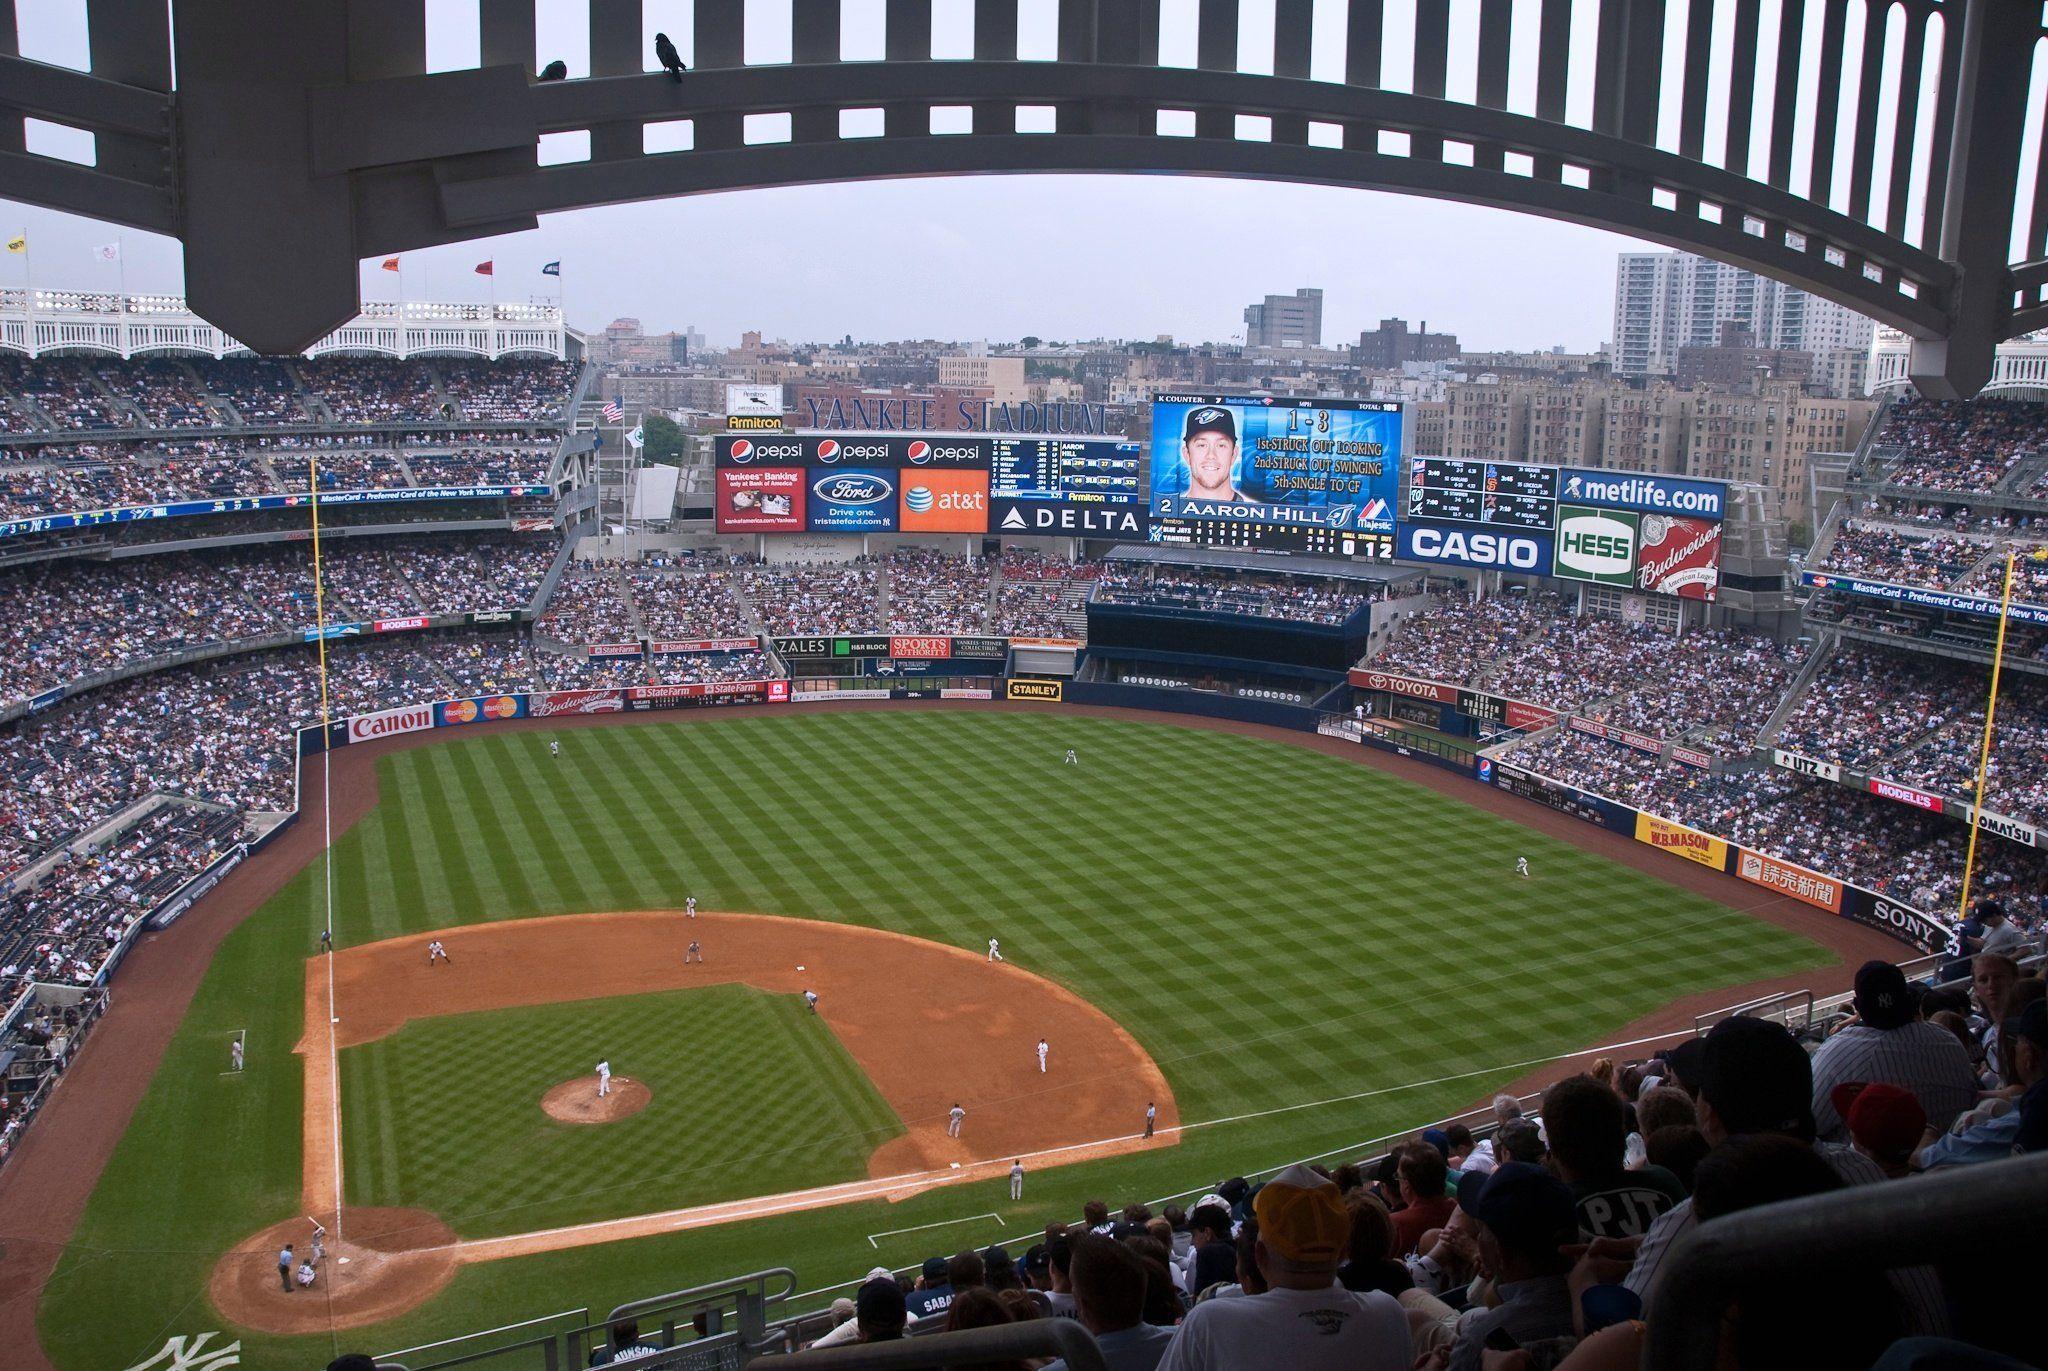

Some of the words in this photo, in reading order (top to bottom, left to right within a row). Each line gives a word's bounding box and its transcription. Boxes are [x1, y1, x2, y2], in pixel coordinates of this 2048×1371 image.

[1165, 396, 1206, 404] COUNTER:
[1359, 403, 1380, 411] TOTAL:
[729, 416, 781, 429] Armitron
[804, 398, 938, 433] YANKEE
[957, 399, 1108, 436] STADIUM
[1289, 409, 1298, 431] 1
[1318, 410, 1329, 432] 3
[756, 443, 802, 459] pepsi
[843, 444, 889, 460] pepsi
[933, 445, 979, 461] pepsi
[1256, 437, 1308, 452] 1st-STRUCK
[1311, 440, 1333, 453] OUT
[1336, 441, 1382, 456] LOOKING
[1255, 457, 1308, 471] 2nd-STRUCK
[1311, 458, 1332, 472] OUT
[1334, 461, 1382, 475] SWINGING
[764, 473, 798, 481] Banking
[1273, 476, 1325, 491] 5th-SINGLE
[1330, 478, 1345, 491] TO
[1348, 480, 1361, 493] CF
[321, 492, 361, 503] MasterCard
[366, 490, 399, 500] Preferred
[400, 490, 417, 499] Card
[418, 489, 426, 499] of
[426, 489, 438, 498] the
[440, 489, 457, 498] New
[458, 488, 474, 497] York
[475, 488, 503, 497] Yankees
[832, 479, 874, 499] Ford
[1585, 479, 1719, 513] metlife.com
[939, 490, 984, 510] at&t
[1068, 493, 1105, 502] Armitron
[152, 507, 168, 517] HILL
[829, 508, 854, 516] Drive
[1160, 499, 1172, 513] 2
[1182, 501, 1266, 519] AARON
[1272, 507, 1325, 524] HILL
[815, 517, 881, 526] tristateford.com
[1036, 508, 1139, 532] DELTA
[1358, 519, 1392, 531] Majestic
[1162, 535, 1190, 543] YANKEES
[1563, 532, 1630, 560] HESS
[1342, 540, 1355, 555] 0
[1365, 542, 1374, 557] 1
[1380, 543, 1392, 559] 2
[1411, 528, 1538, 569] CASIO
[1637, 523, 1722, 589] Budweiser
[1668, 573, 1696, 588] American
[1697, 572, 1714, 581] Lager
[1852, 582, 1901, 598] MasterCard
[1908, 591, 1950, 606] Preferred
[1952, 597, 1973, 611] Card
[1975, 602, 1987, 612] of
[1988, 604, 2002, 614] the
[2006, 606, 2031, 619] New
[381, 619, 423, 631] MODELL'S
[779, 640, 825, 653] ZALES
[893, 638, 947, 650] SPORTS
[1013, 685, 1057, 696] STANLEY
[1389, 678, 1438, 699] TOYOTA
[540, 690, 610, 716] Budweiser
[1463, 698, 1500, 714] SHARPER
[1475, 694, 1489, 704] THE
[444, 708, 476, 718] MasterCard
[483, 704, 516, 713] MasterCard
[1468, 707, 1494, 720] IMAGE
[353, 709, 431, 738] Canon
[1572, 718, 1604, 735] MODELL'S
[1624, 734, 1658, 751] MODELL'S
[1673, 749, 1709, 765] MODELL'S
[1498, 765, 1526, 781] GATORADE
[1793, 758, 1818, 775] UTZ
[1878, 783, 1932, 808] MODELL'S
[1763, 861, 1835, 906] 読売新聞
[1874, 900, 1934, 943] SONY
[924, 1294, 956, 1313] SABA
